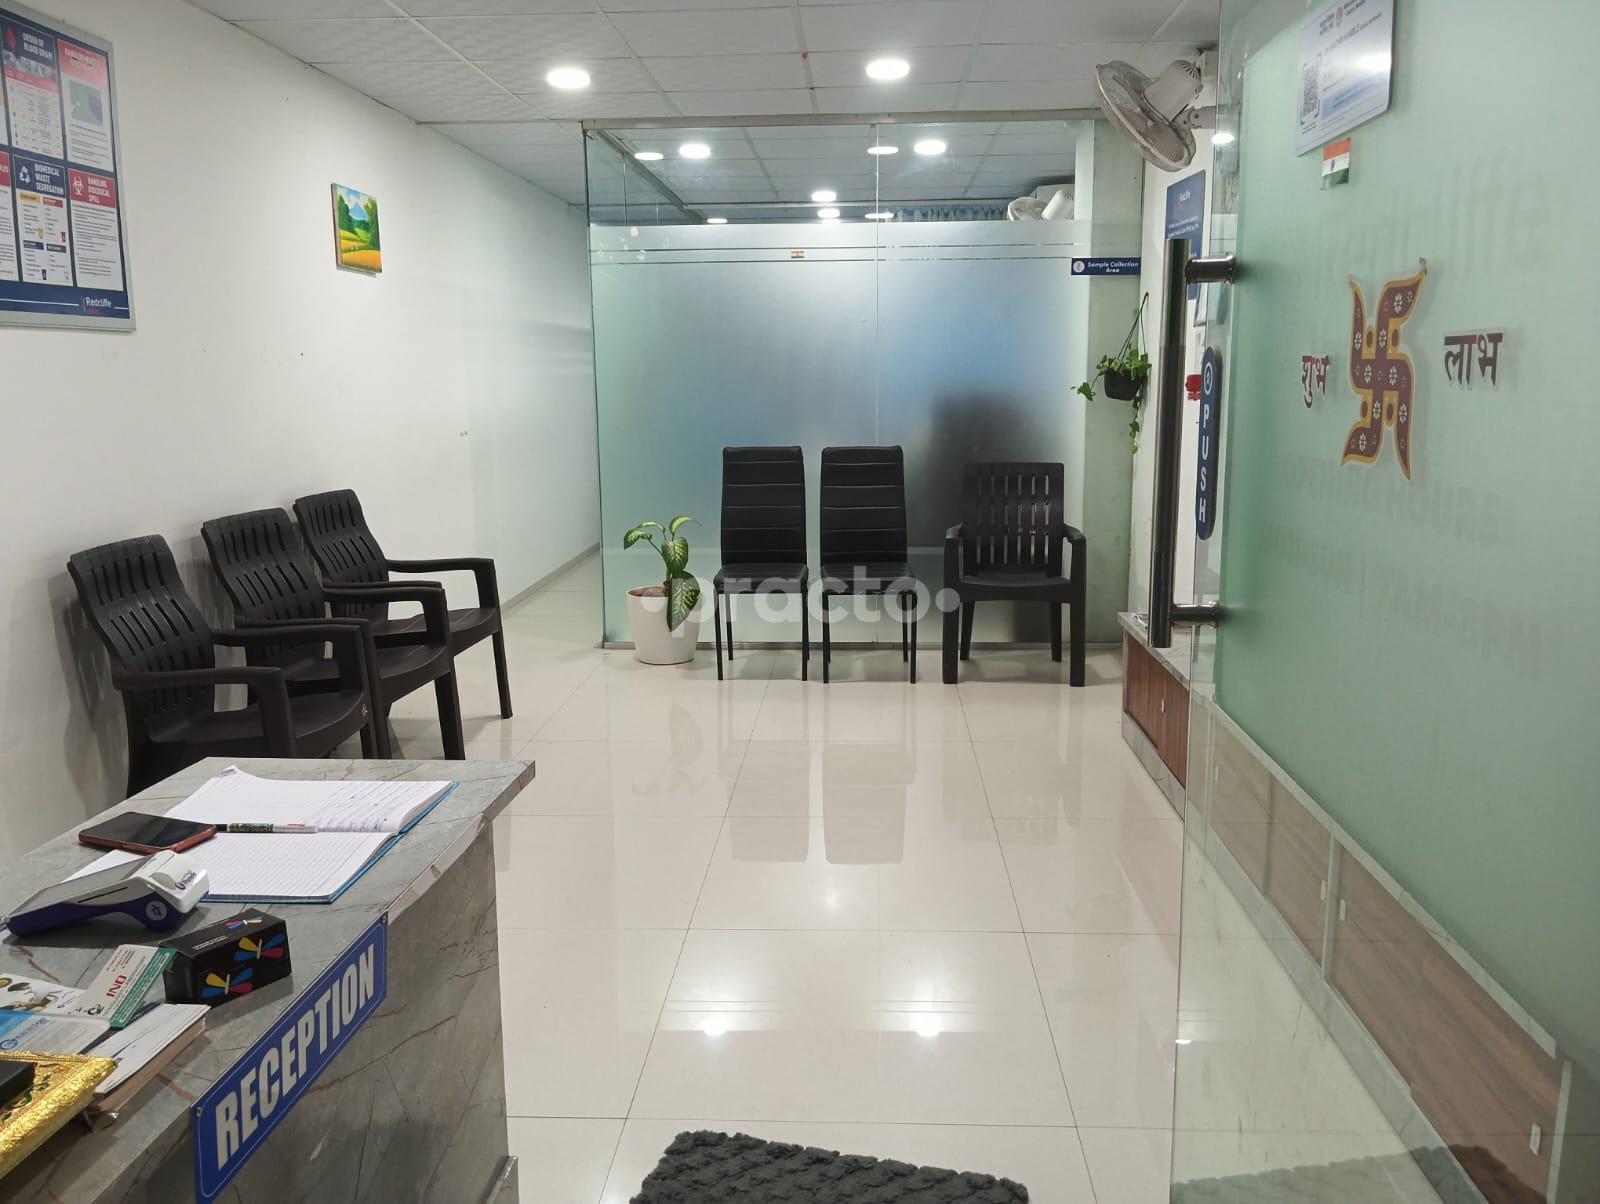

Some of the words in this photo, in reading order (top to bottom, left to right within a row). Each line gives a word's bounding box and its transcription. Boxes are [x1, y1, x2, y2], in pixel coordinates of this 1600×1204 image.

[1087, 261, 1109, 269] Sample
[1301, 355, 1330, 409] शुभ
[1444, 332, 1504, 387] लाभ
[1198, 403, 1211, 523] PUSH
[215, 943, 376, 1172] RECEPTION
